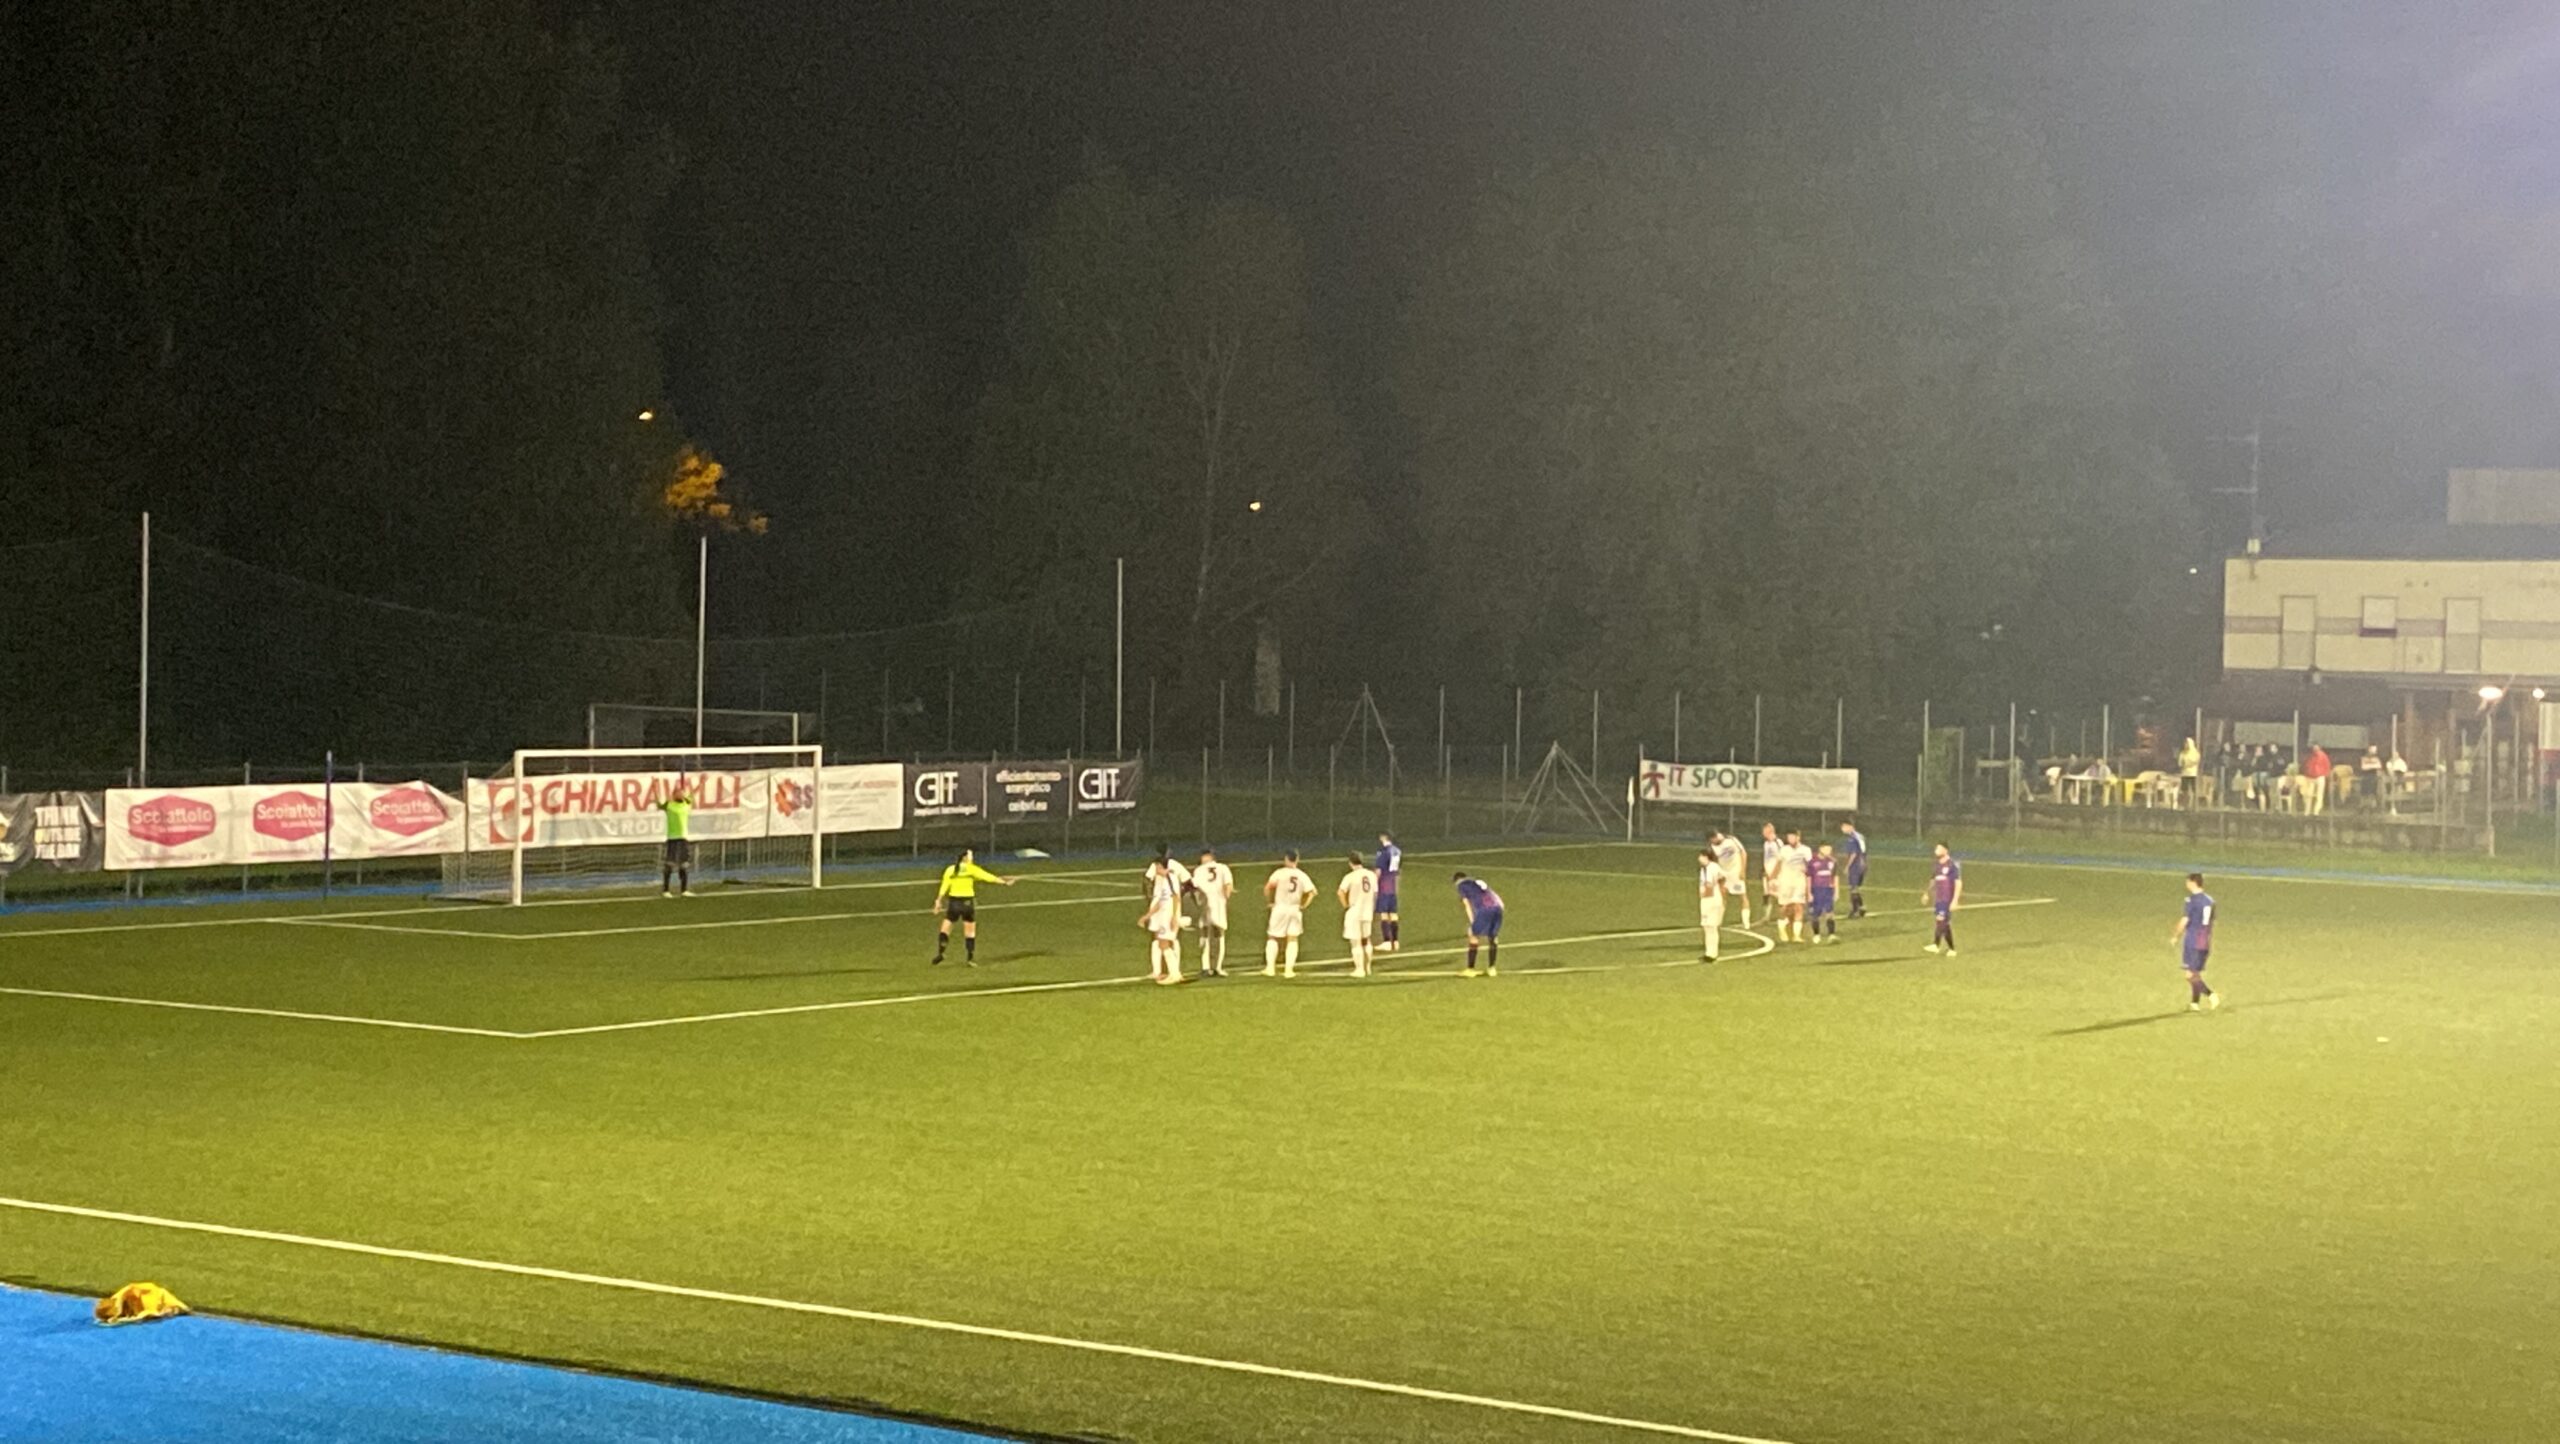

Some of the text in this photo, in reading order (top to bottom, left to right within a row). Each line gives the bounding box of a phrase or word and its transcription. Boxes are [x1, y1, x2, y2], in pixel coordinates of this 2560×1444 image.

[1668, 766, 1686, 787] IT
[1690, 767, 1762, 791] SPORT
[131, 807, 213, 825] Scoattolo
[256, 801, 327, 821] Scoiattol
[607, 817, 667, 837] GROU
[1288, 876, 1299, 893] 5
[1361, 875, 1371, 893] 6
